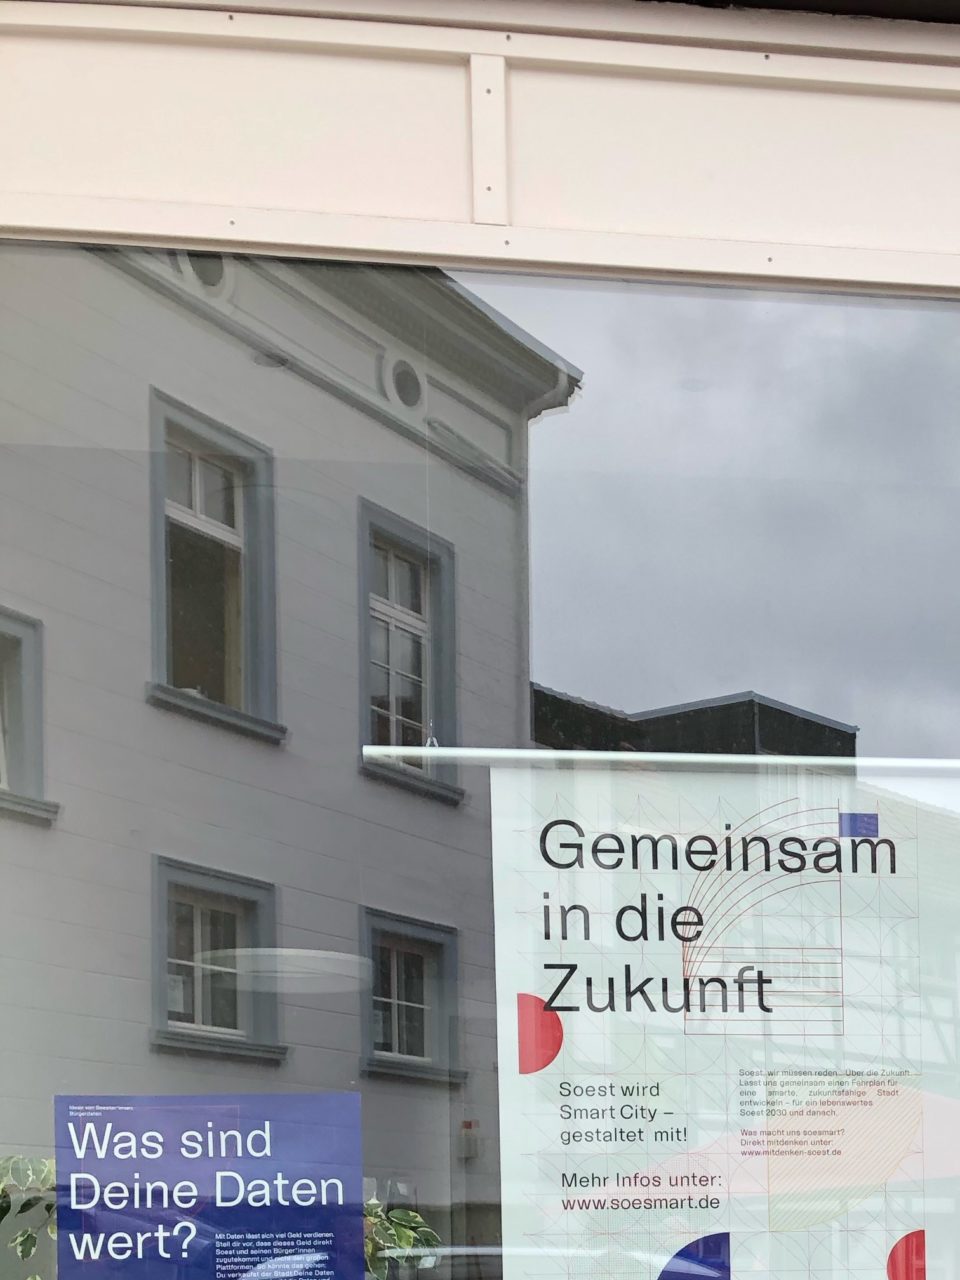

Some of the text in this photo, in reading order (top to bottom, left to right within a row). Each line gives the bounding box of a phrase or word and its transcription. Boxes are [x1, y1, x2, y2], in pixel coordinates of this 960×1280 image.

[539, 818, 897, 874] Gemeinsam
[543, 891, 704, 943] in die
[543, 963, 773, 1013] Zukunft
[559, 1081, 660, 1097] Soest wird
[560, 1105, 615, 1120] Smart
[620, 1104, 657, 1122] City
[68, 1120, 272, 1159] Was sind
[561, 1127, 687, 1145] gestaltet mit!
[70, 1171, 344, 1210] Deine Daten
[562, 1172, 722, 1187] Mehr Infos unter:
[562, 1195, 720, 1210] www.soesmart.de
[69, 1221, 197, 1260] wert?
